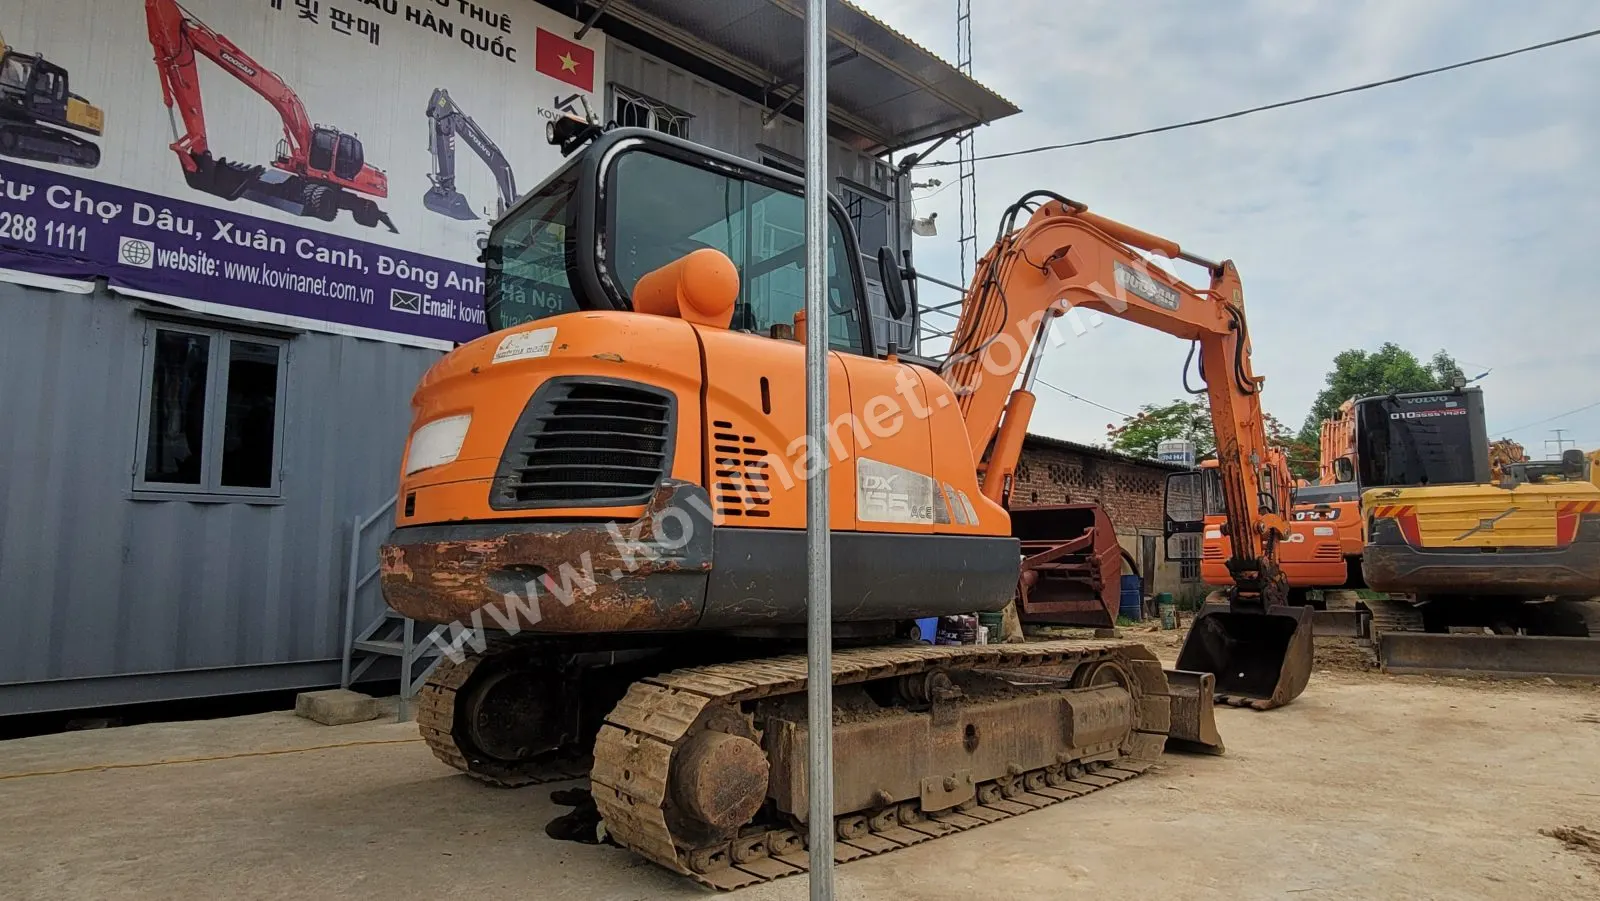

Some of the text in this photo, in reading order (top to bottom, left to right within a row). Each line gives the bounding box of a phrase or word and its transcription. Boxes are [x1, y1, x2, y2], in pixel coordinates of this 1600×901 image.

[329, 7, 380, 46] 판매
[405, 5, 454, 38] HÀN
[460, 28, 517, 63] QUỐC
[457, 0, 512, 34] THUÊ
[467, 129, 491, 157] VOLVO
[0, 211, 87, 252] 288 1111
[46, 185, 123, 224] Chợ
[132, 202, 202, 241] Dâu,
[212, 219, 286, 254] Xuân
[295, 238, 369, 275] Canh,
[377, 255, 439, 290] Đông
[157, 246, 374, 306] website: www.kovinanet.com.vn
[423, 294, 457, 320] Email:
[1408, 395, 1448, 404] VOLVO
[862, 474, 899, 490] DX
[911, 505, 932, 519] ACE
